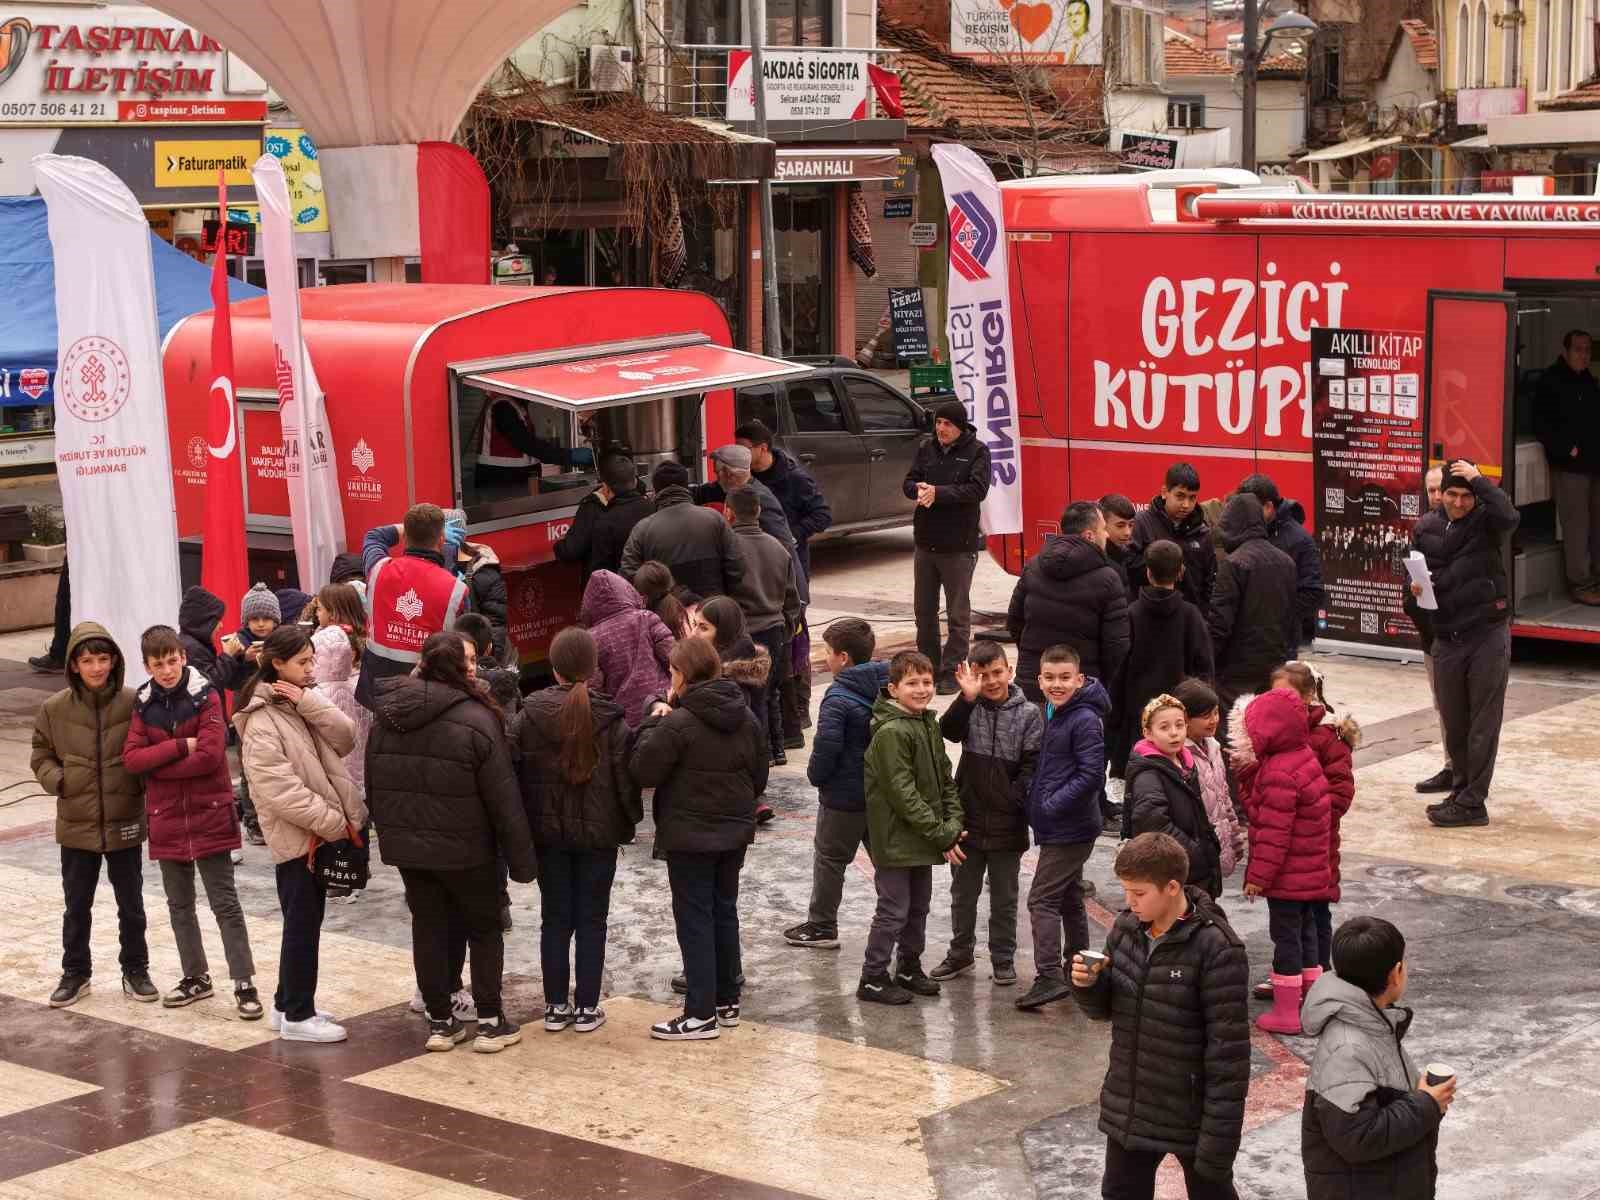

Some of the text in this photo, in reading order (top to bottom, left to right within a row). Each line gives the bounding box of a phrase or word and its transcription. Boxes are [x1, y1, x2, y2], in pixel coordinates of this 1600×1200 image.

[763, 57, 859, 80] AKDAĞ SİGORTA
[45, 59, 216, 99] İLETİŞİM
[2, 104, 105, 116] 0507 506 41 21
[264, 142, 285, 153] OST
[178, 155, 247, 171] Faturamatik
[824, 160, 853, 175] HALI
[1292, 201, 1442, 220] KÜTÜPHANELER
[1446, 204, 1473, 220] VE
[1475, 204, 1579, 221] YAYIMLAR
[1142, 262, 1349, 358] GEZİCİ
[1330, 332, 1423, 357] AKILLI KİTAP
[1352, 357, 1401, 370] TEKNOLOJİSİ
[348, 481, 382, 493] VAKIFLAR
[387, 623, 429, 640] VAKIFLAR
[335, 860, 349, 868] THE
